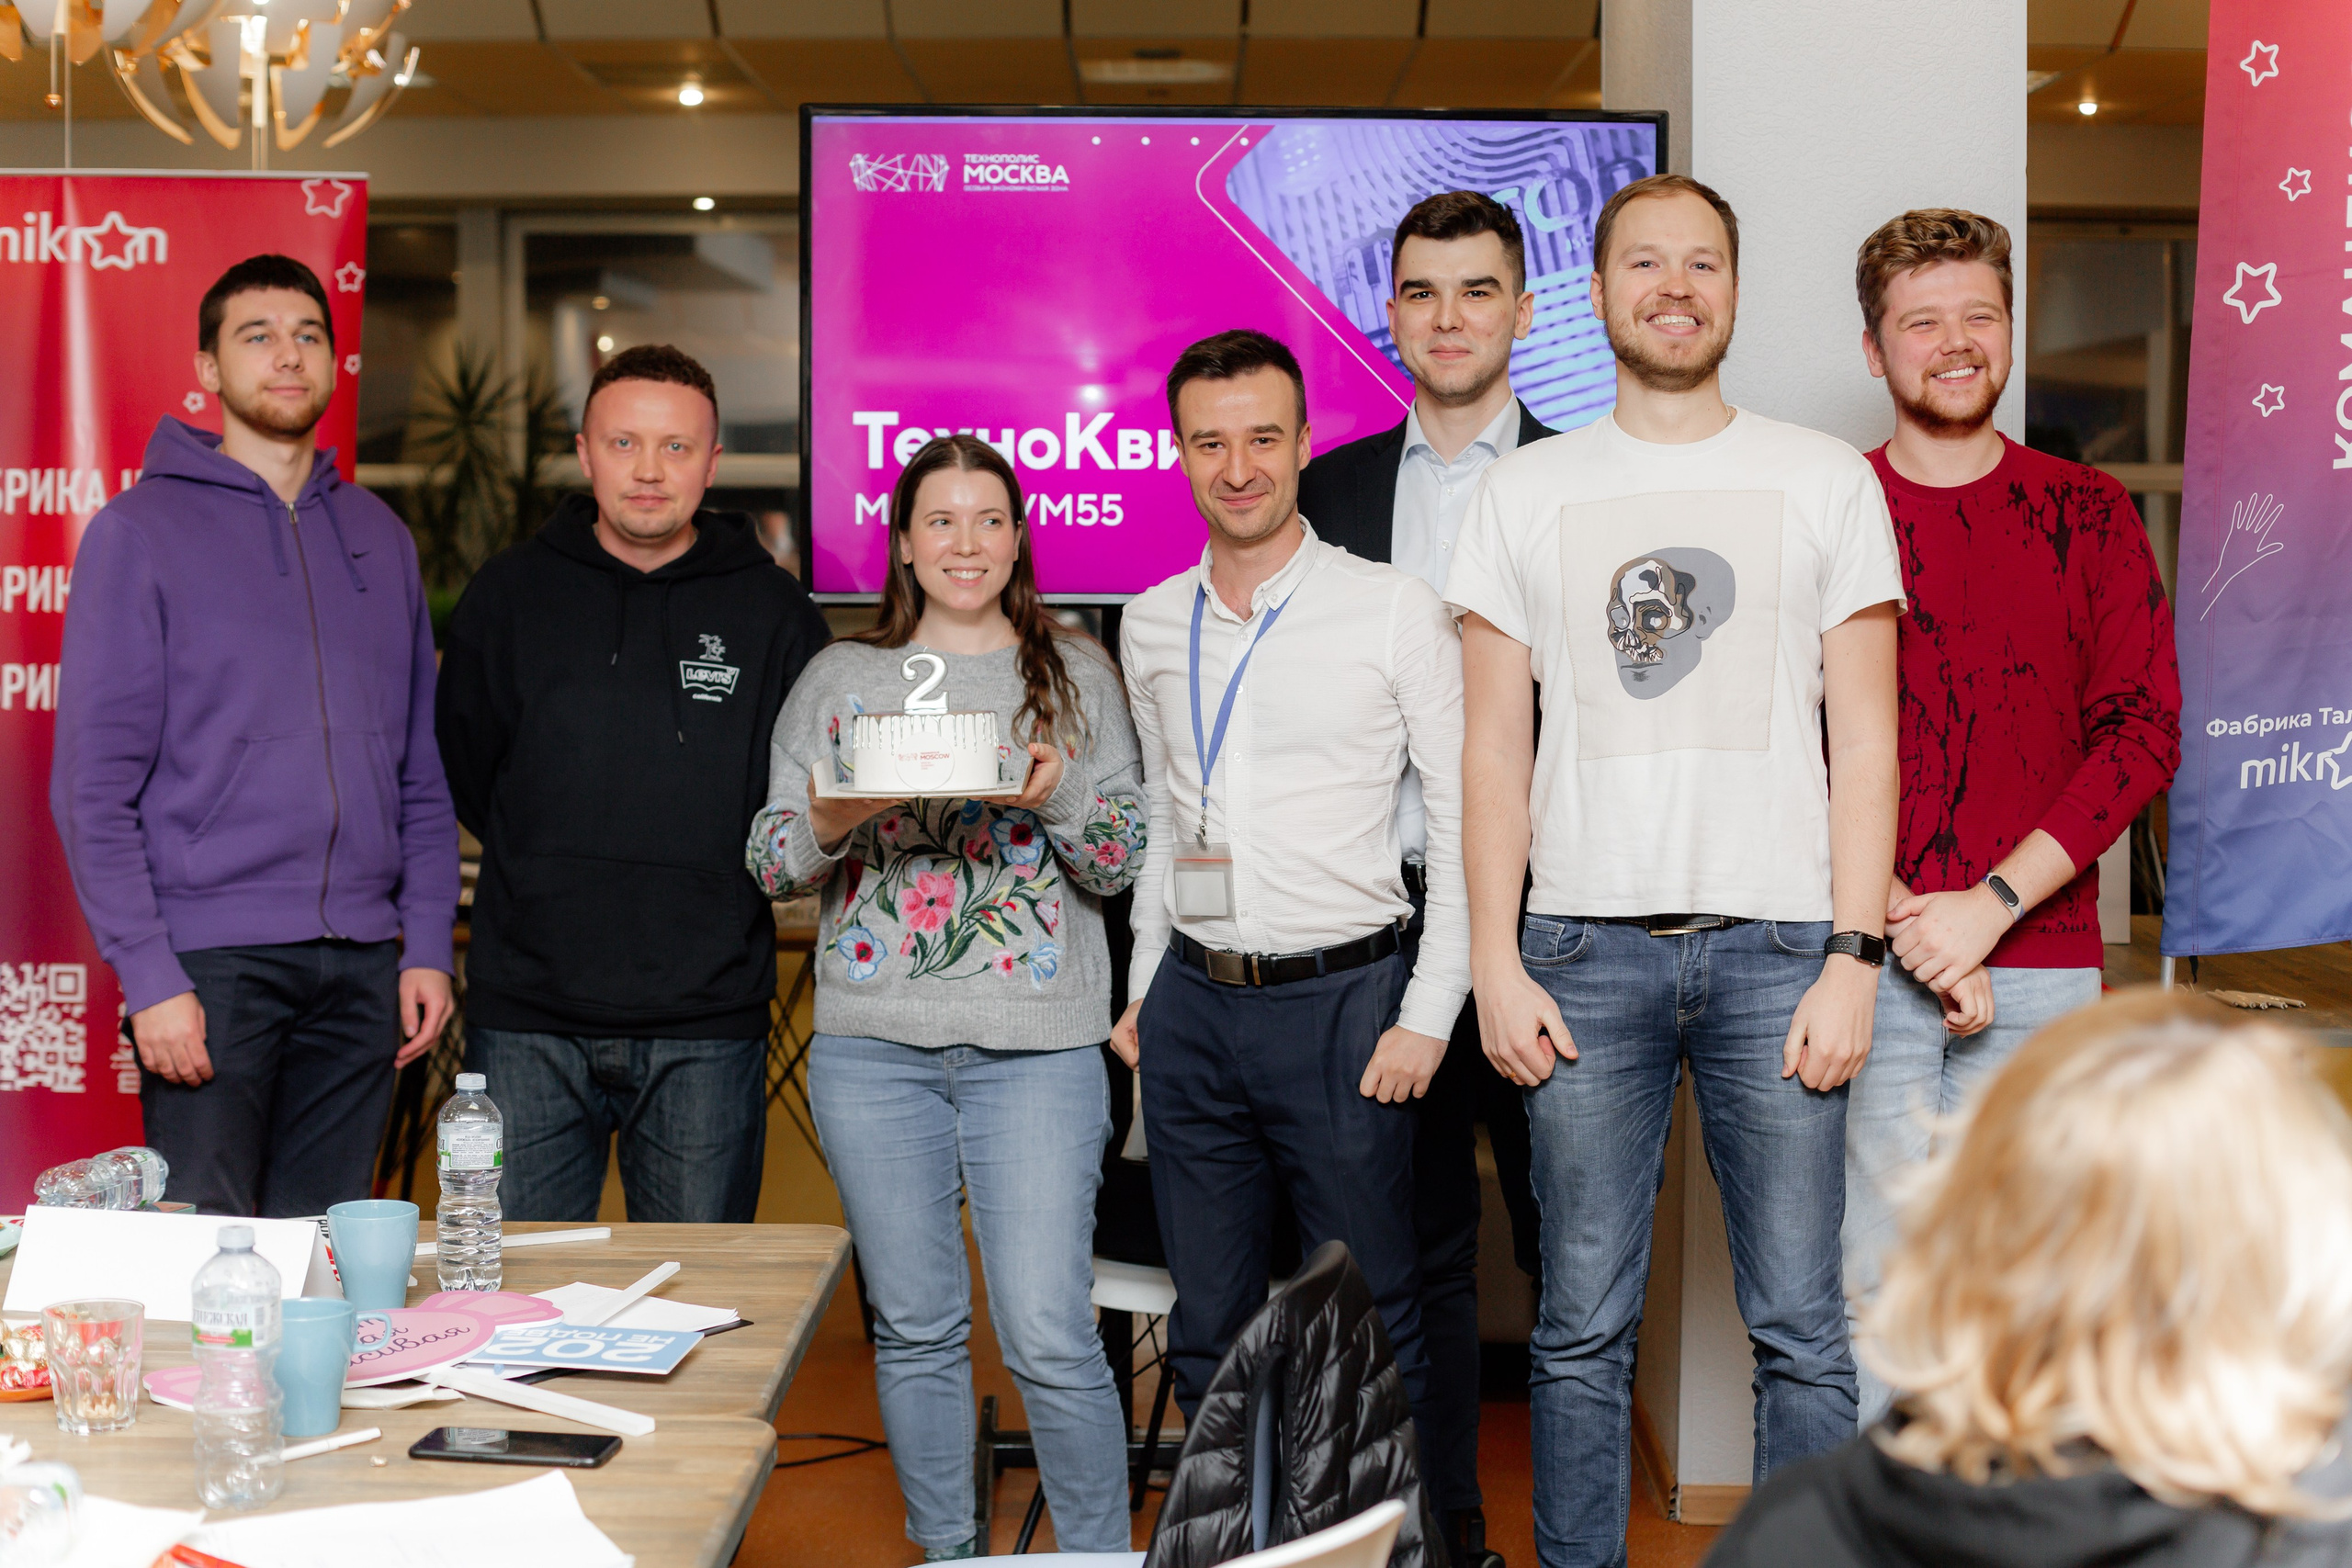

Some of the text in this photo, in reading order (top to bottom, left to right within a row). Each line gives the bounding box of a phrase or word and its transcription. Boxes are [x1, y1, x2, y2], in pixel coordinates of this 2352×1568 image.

[963, 153, 1040, 164] ТЕХНОПОЛИС
[963, 164, 1070, 184] МОСКВА
[853, 411, 1180, 470] ТеноКви
[0, 468, 107, 515] РИКА
[900, 652, 949, 713] 2
[2206, 713, 2312, 738] Фабрика
[627, 1334, 676, 1345] НЕ
